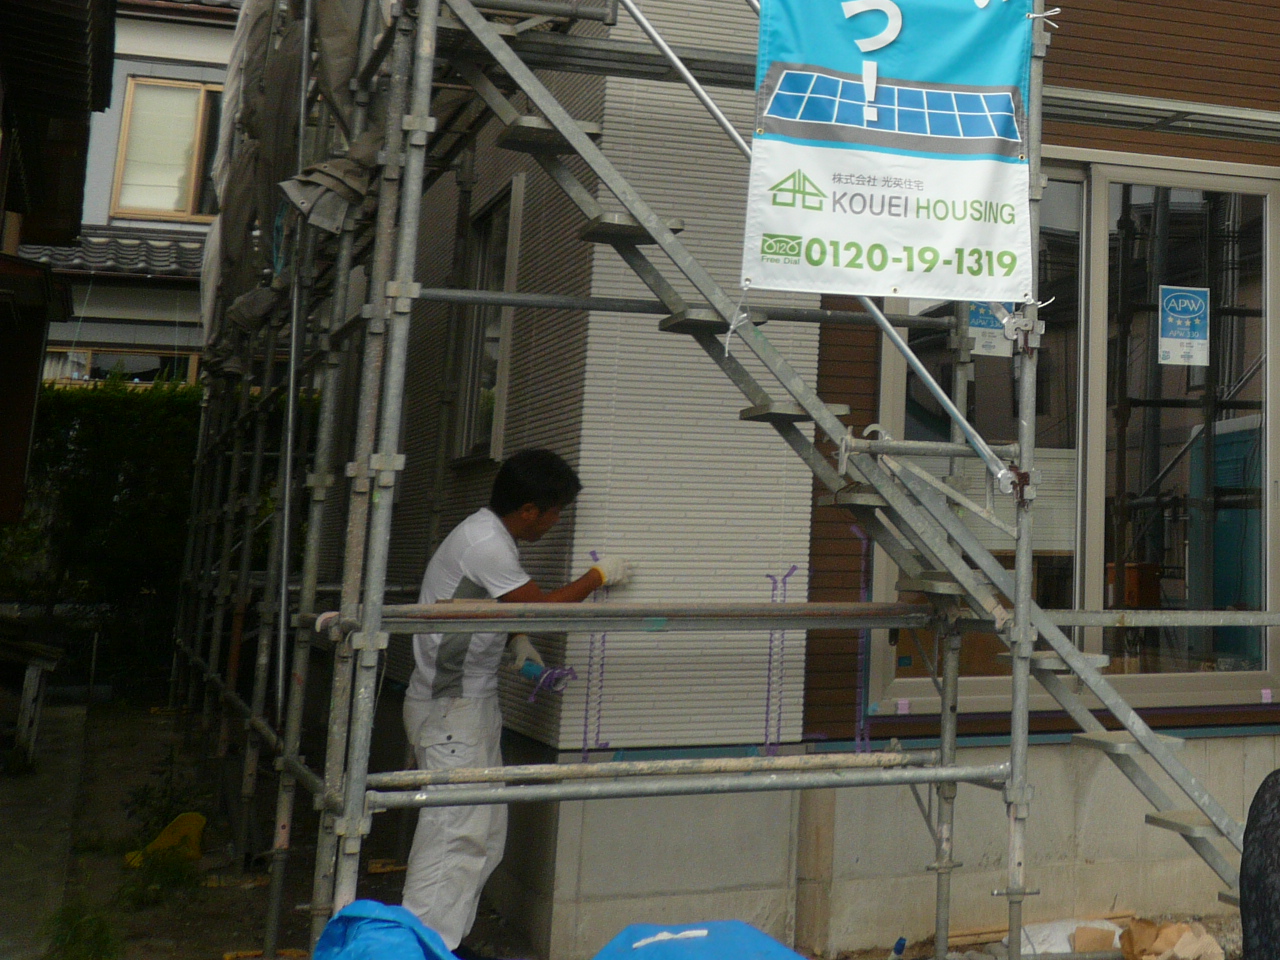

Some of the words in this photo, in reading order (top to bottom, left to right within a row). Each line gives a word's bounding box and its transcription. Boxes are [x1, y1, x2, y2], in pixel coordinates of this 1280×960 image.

[832, 172, 878, 187] 株式会社
[881, 176, 925, 191] 光英住宅
[832, 190, 908, 218] KOUEI
[916, 197, 1016, 225] HOUSING
[761, 255, 781, 264] Free
[783, 257, 800, 265] Dial
[804, 237, 1018, 278] 0120-19-1319
[1167, 298, 1201, 311] APW
